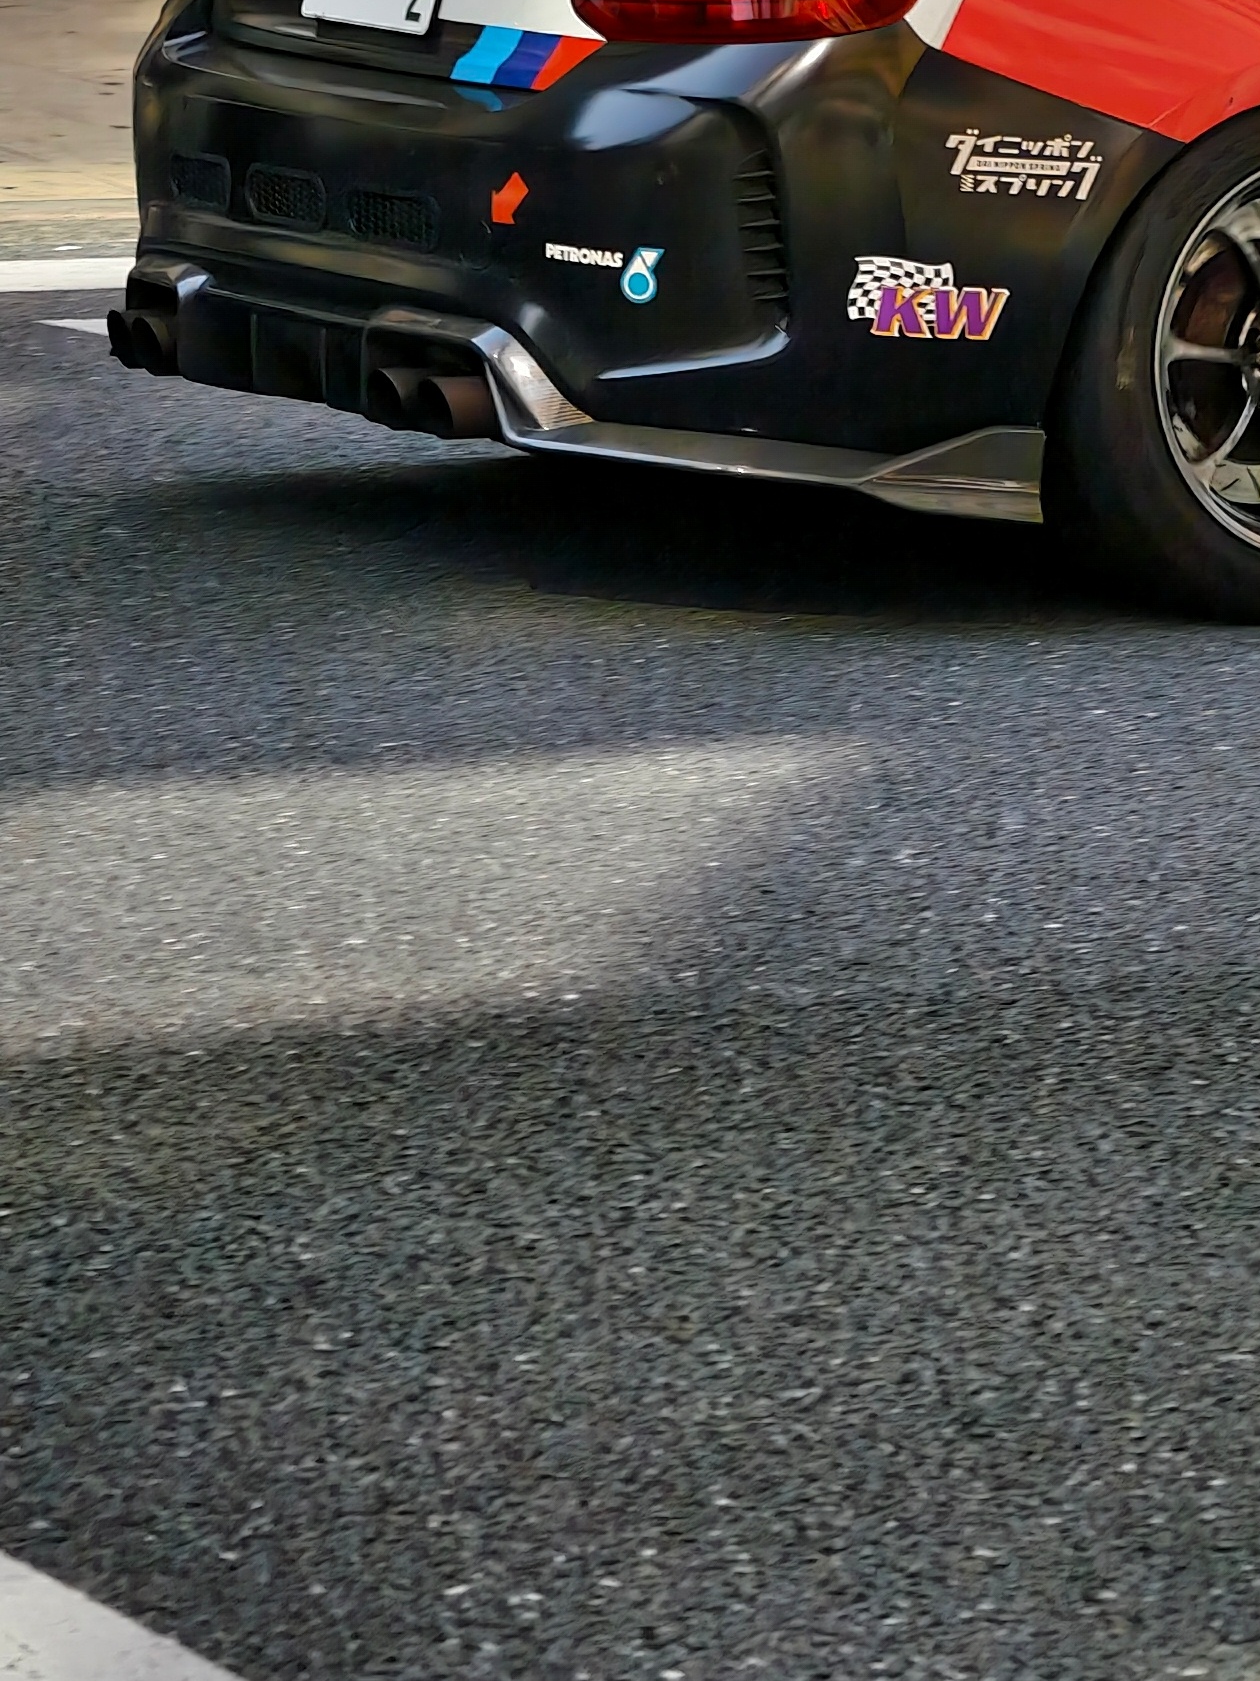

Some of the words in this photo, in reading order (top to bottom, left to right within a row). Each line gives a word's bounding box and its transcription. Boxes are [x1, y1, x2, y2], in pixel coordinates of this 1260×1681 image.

[945, 128, 1095, 176] ダイニッポン
[545, 242, 624, 268] PETRONAS
[870, 285, 1010, 340] KW
